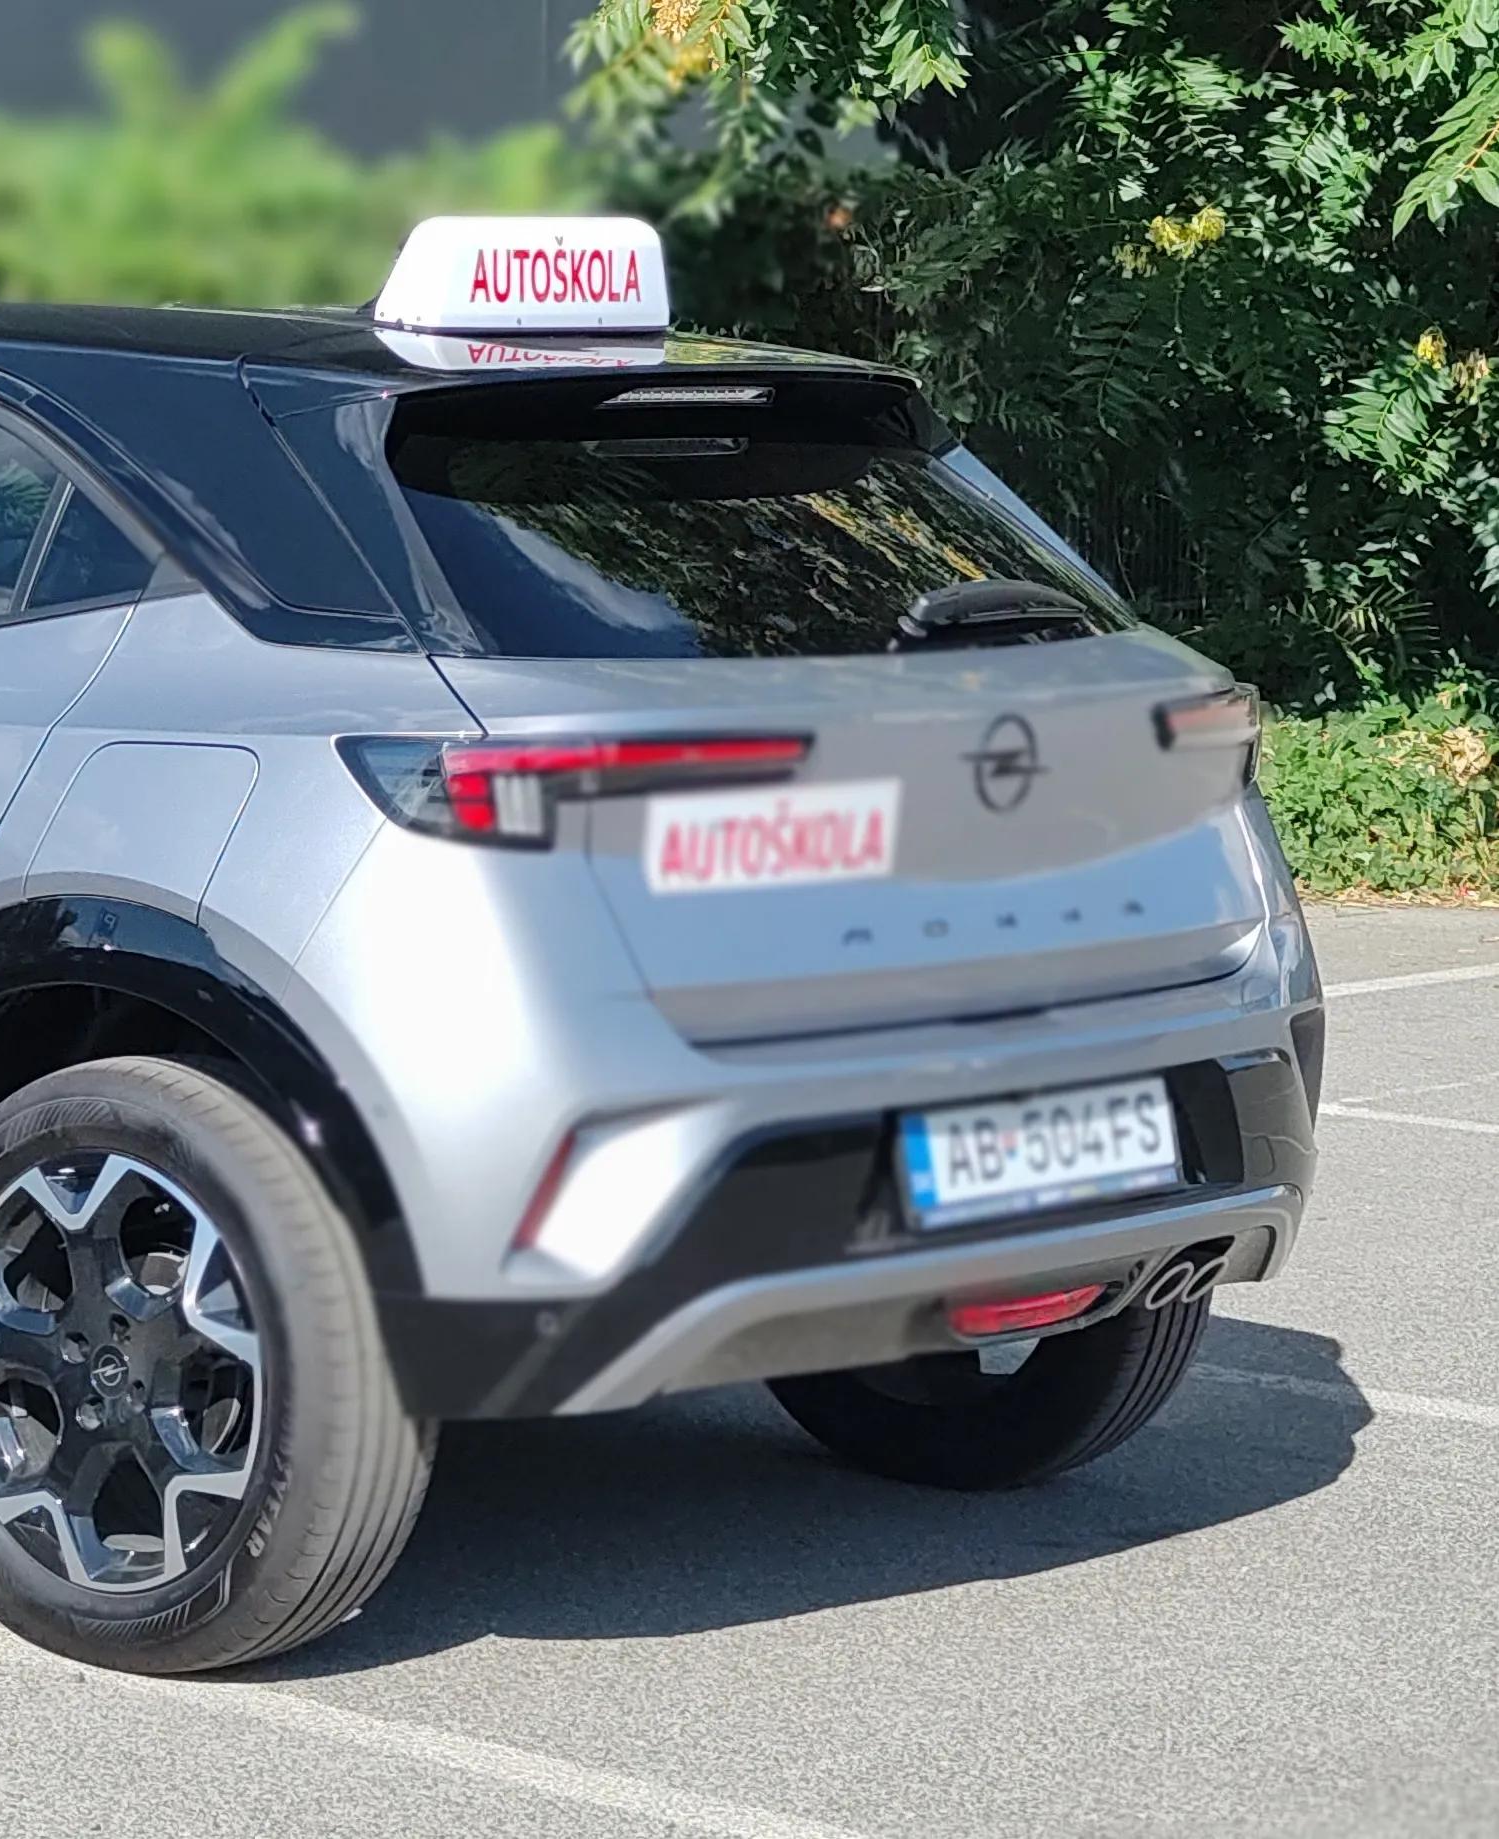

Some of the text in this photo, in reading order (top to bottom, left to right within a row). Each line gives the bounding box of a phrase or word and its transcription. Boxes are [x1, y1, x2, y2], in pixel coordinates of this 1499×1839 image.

[469, 236, 641, 303] AUTOŠKOLA
[660, 799, 884, 880] AUTOŠKOLA
[948, 1090, 1161, 1188] AB 504FS
